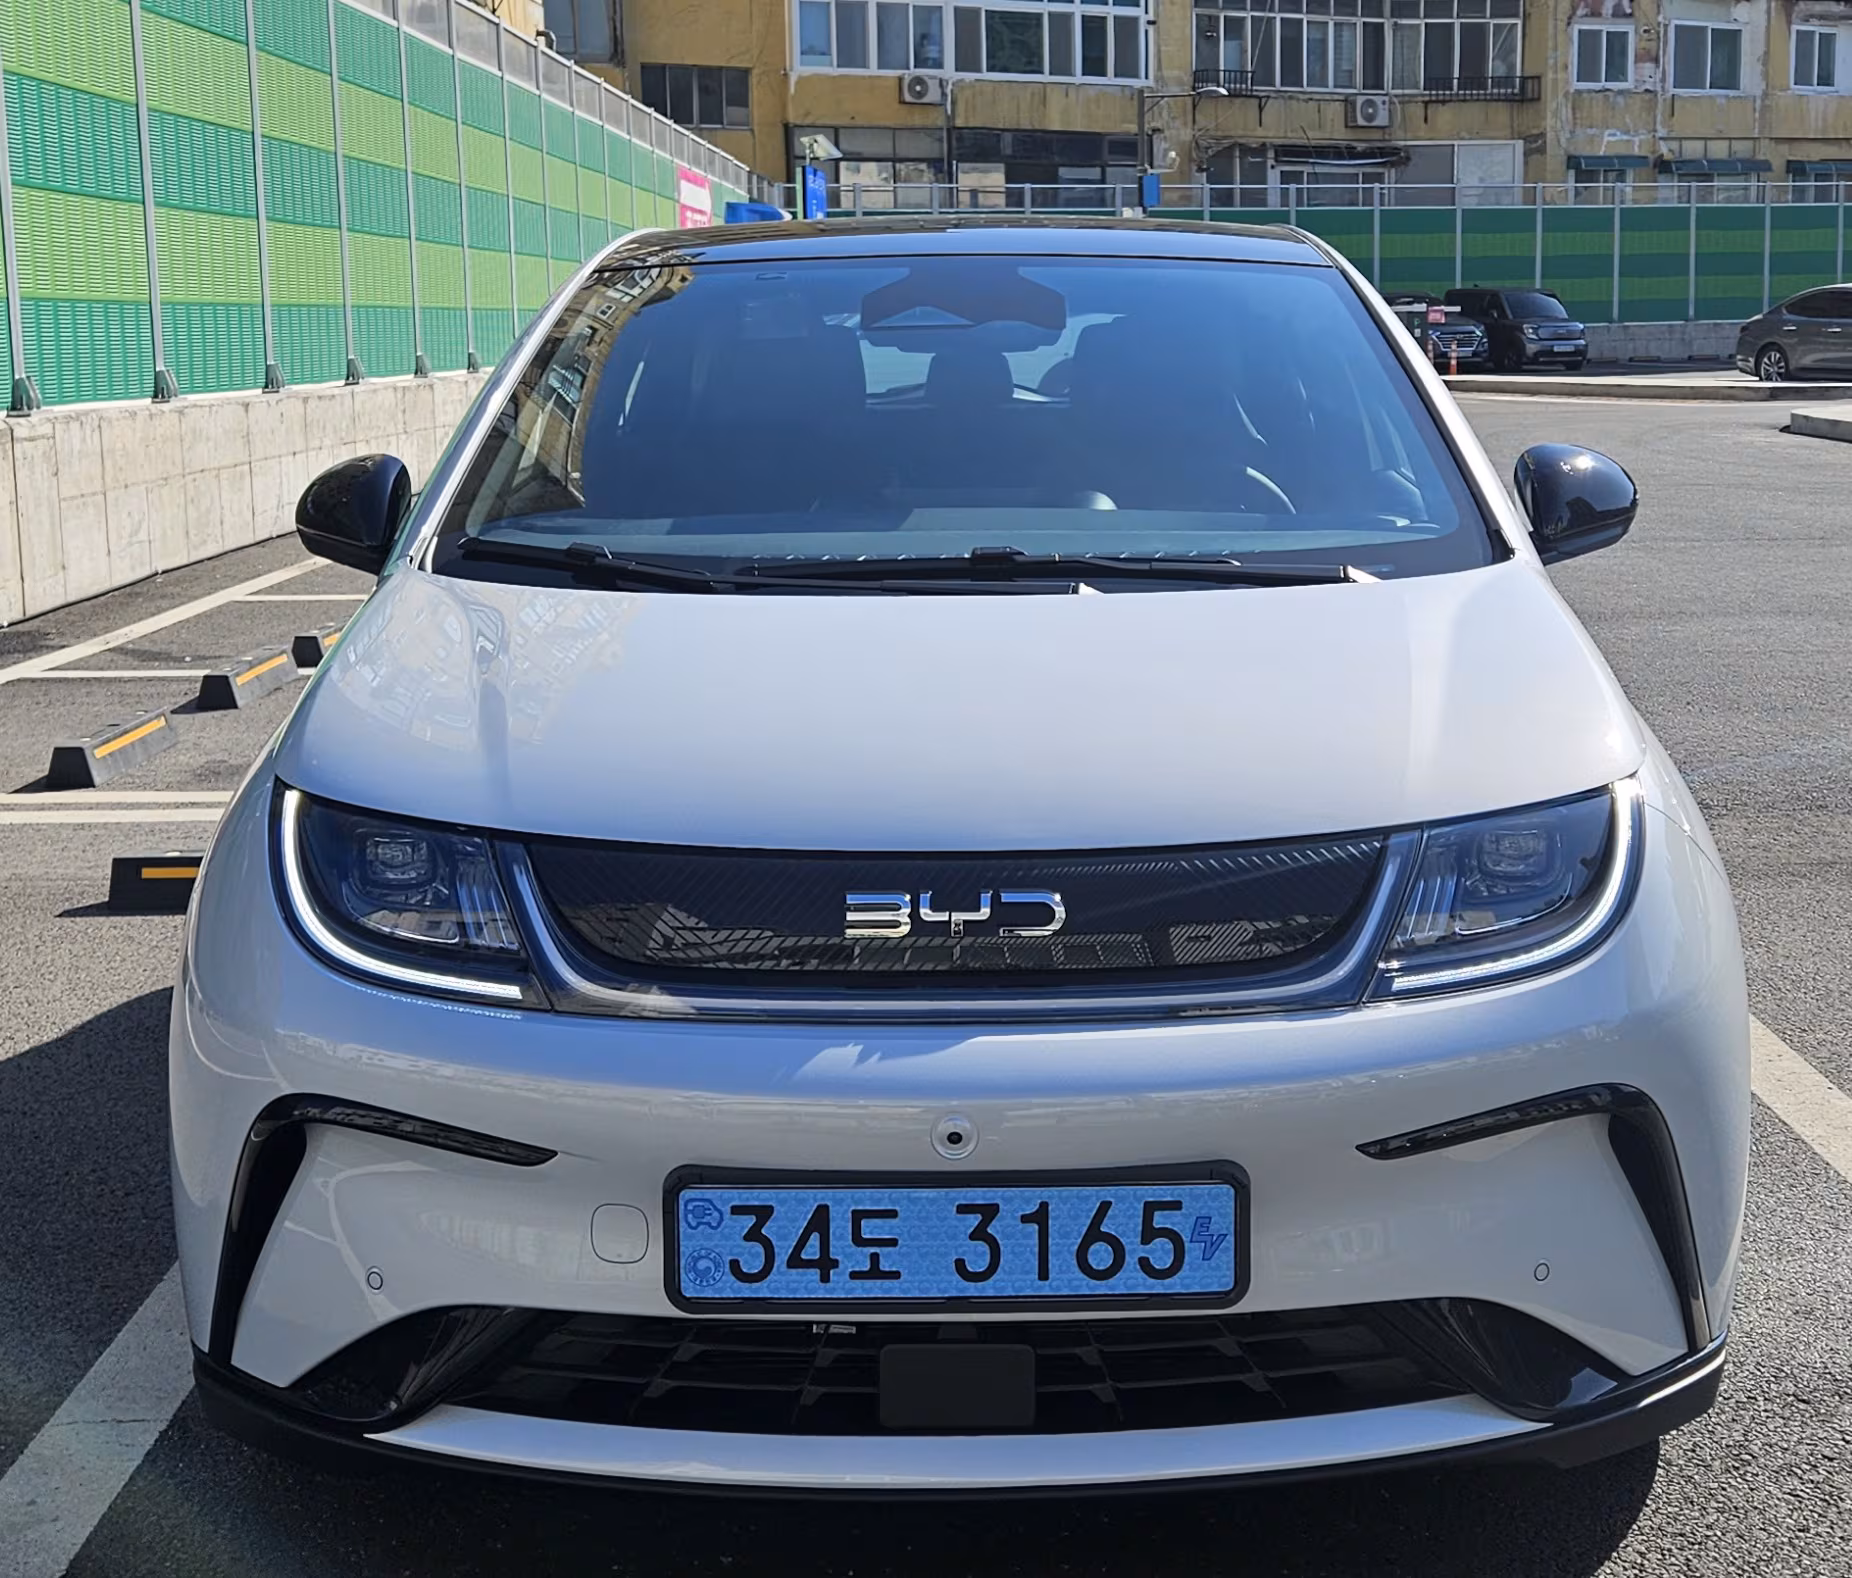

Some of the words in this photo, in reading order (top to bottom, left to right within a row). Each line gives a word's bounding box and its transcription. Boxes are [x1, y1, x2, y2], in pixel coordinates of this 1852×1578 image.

[844, 890, 1067, 939] BYD
[729, 1202, 902, 1284] 34도
[953, 1200, 1186, 1283] 3165
[1190, 1216, 1229, 1261] EV
